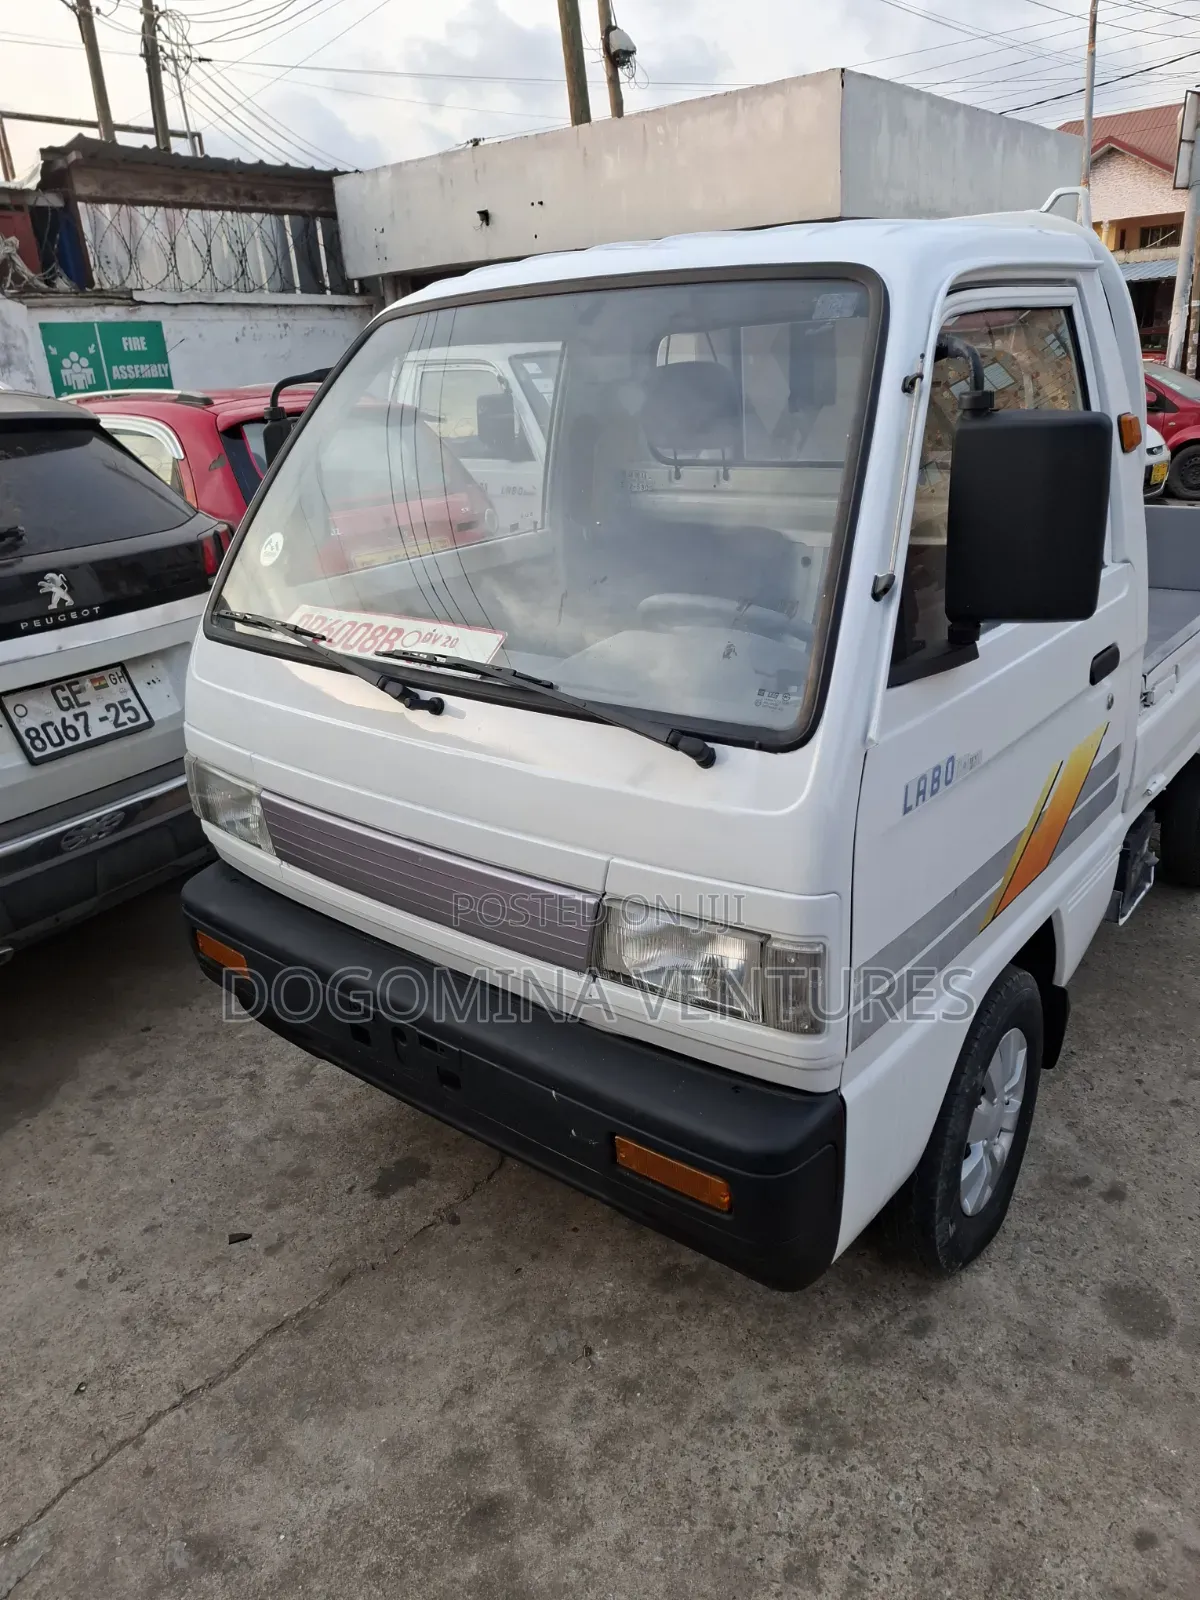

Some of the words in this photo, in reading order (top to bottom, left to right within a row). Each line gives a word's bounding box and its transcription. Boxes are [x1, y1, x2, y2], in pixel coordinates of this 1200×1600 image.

[121, 336, 148, 351] FIRE
[112, 363, 170, 380] ASSEMBLY
[20, 606, 100, 630] PEUGEOT
[50, 680, 91, 712] GE
[109, 670, 128, 686] GH
[902, 755, 955, 816] LABO
